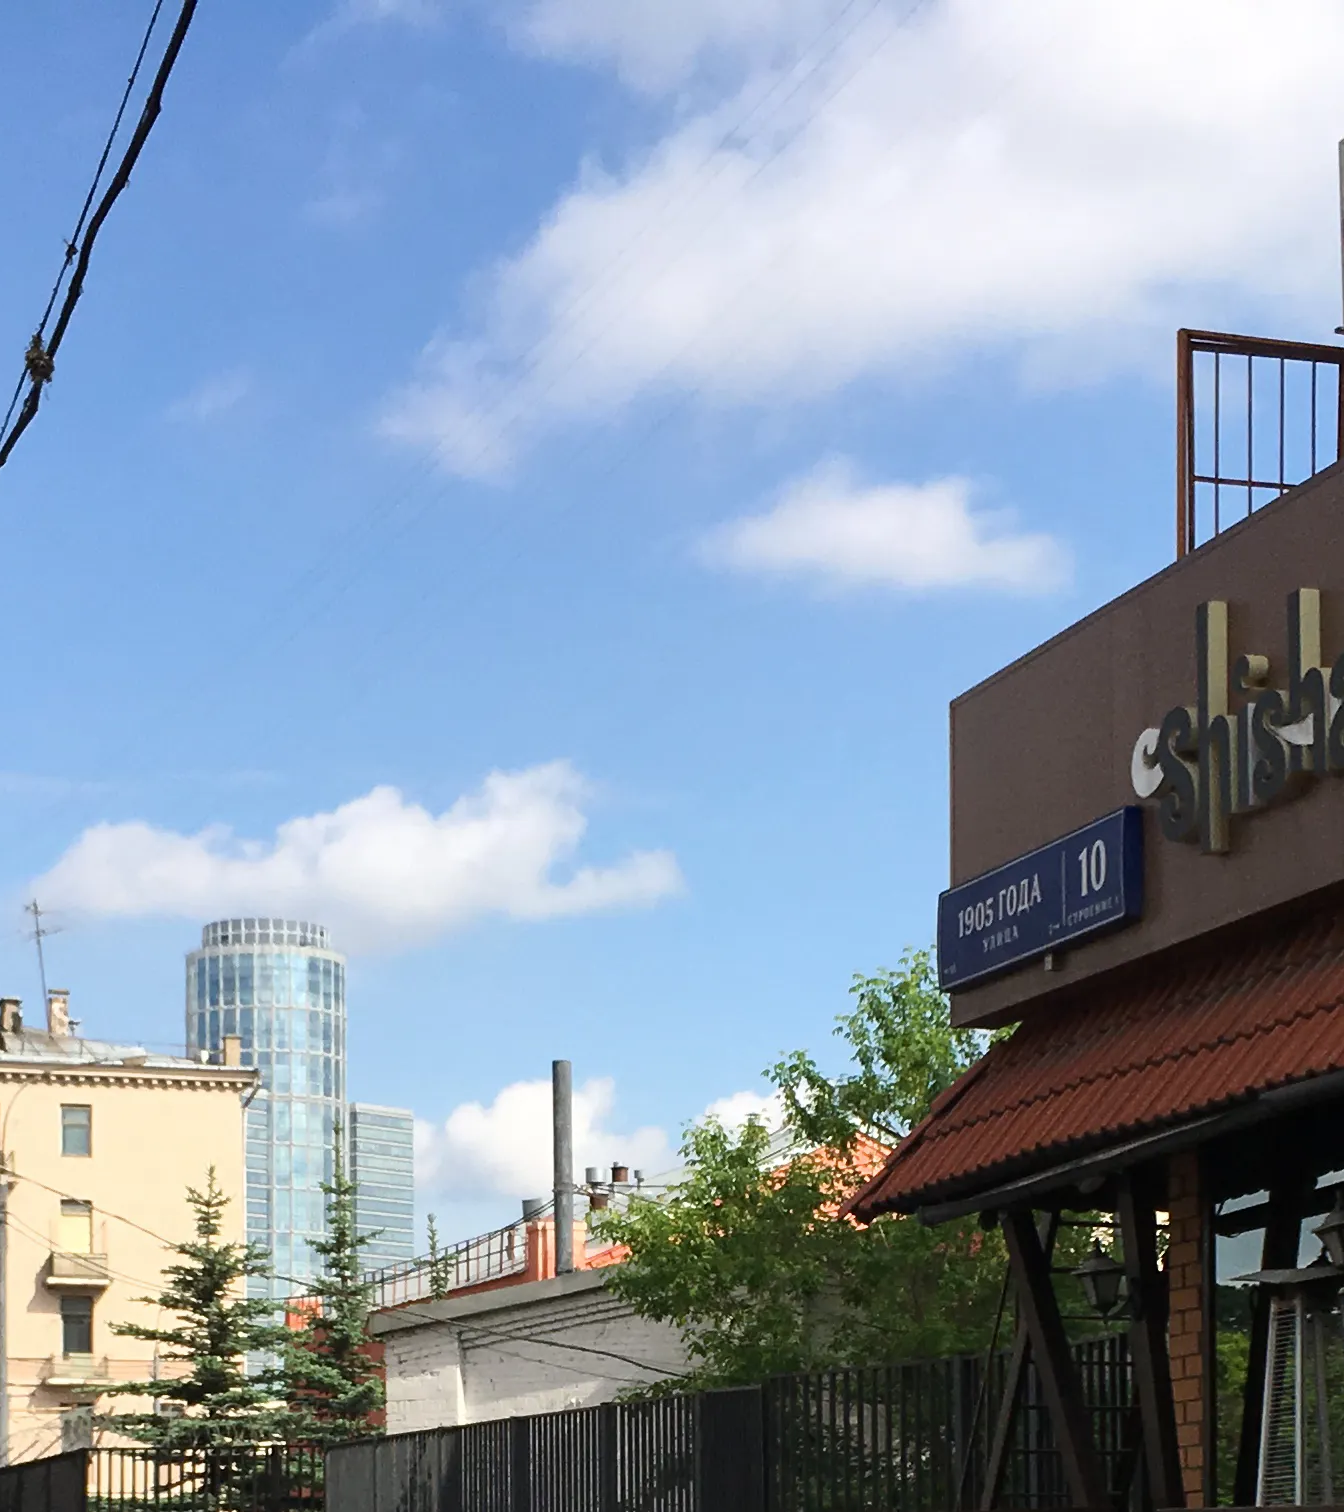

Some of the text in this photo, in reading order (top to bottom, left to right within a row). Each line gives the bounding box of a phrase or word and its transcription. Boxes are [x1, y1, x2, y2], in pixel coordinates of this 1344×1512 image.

[1077, 838, 1107, 897] 10
[958, 872, 1042, 939] 1905 ГОДА
[1067, 896, 1114, 927] СТРОЕНИЕ
[982, 924, 1019, 953] УЛИЦА
